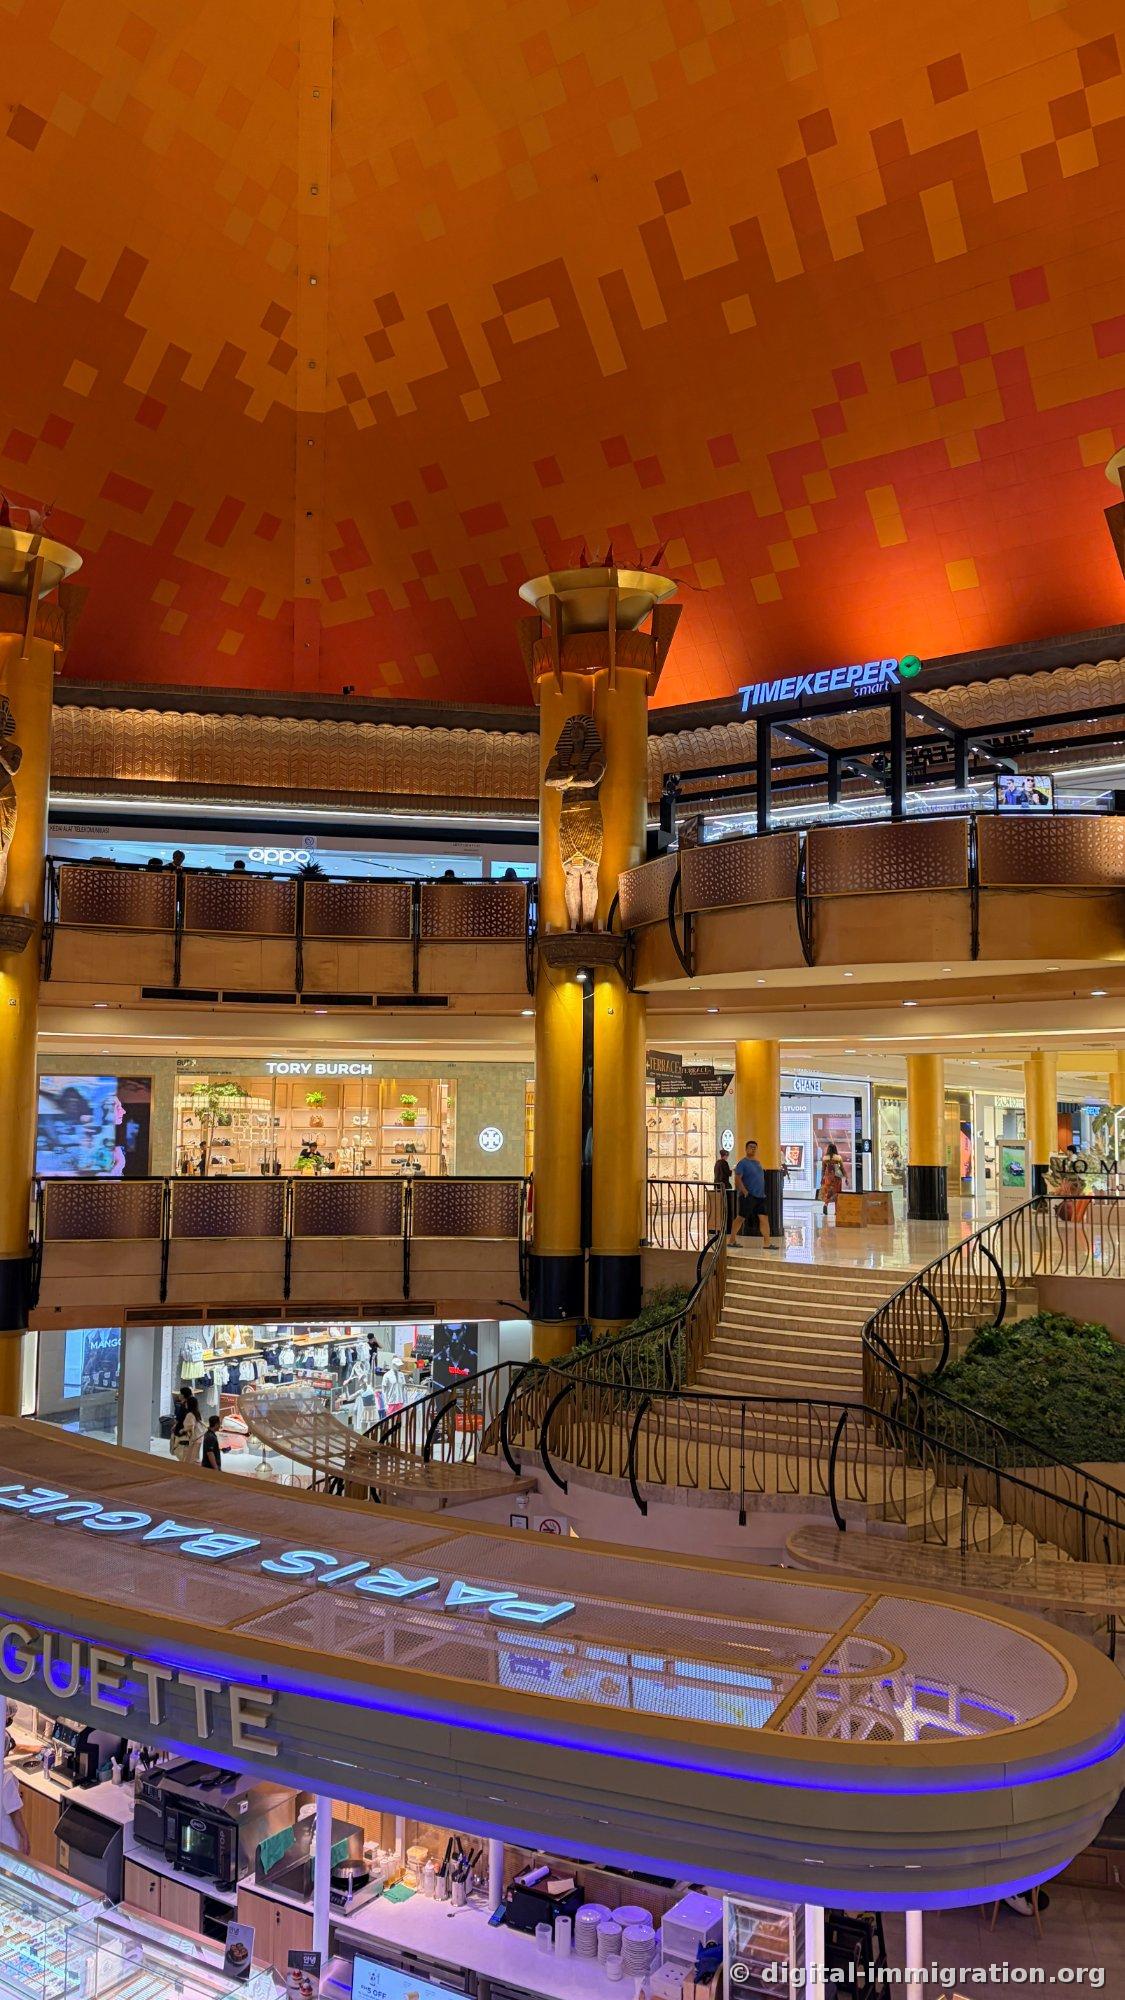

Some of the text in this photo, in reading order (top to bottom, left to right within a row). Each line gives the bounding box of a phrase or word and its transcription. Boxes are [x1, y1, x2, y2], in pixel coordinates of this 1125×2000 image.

[739, 658, 900, 711] TIMEKEEPER
[854, 681, 890, 697] smart
[248, 849, 311, 866] oppo
[266, 1062, 373, 1075] TORY BURCH
[794, 1079, 824, 1092] CHANEL
[261, 1551, 576, 1625] PARIS
[0, 1623, 279, 1757] GUETTE
[372, 1990, 388, 1999] OFF
